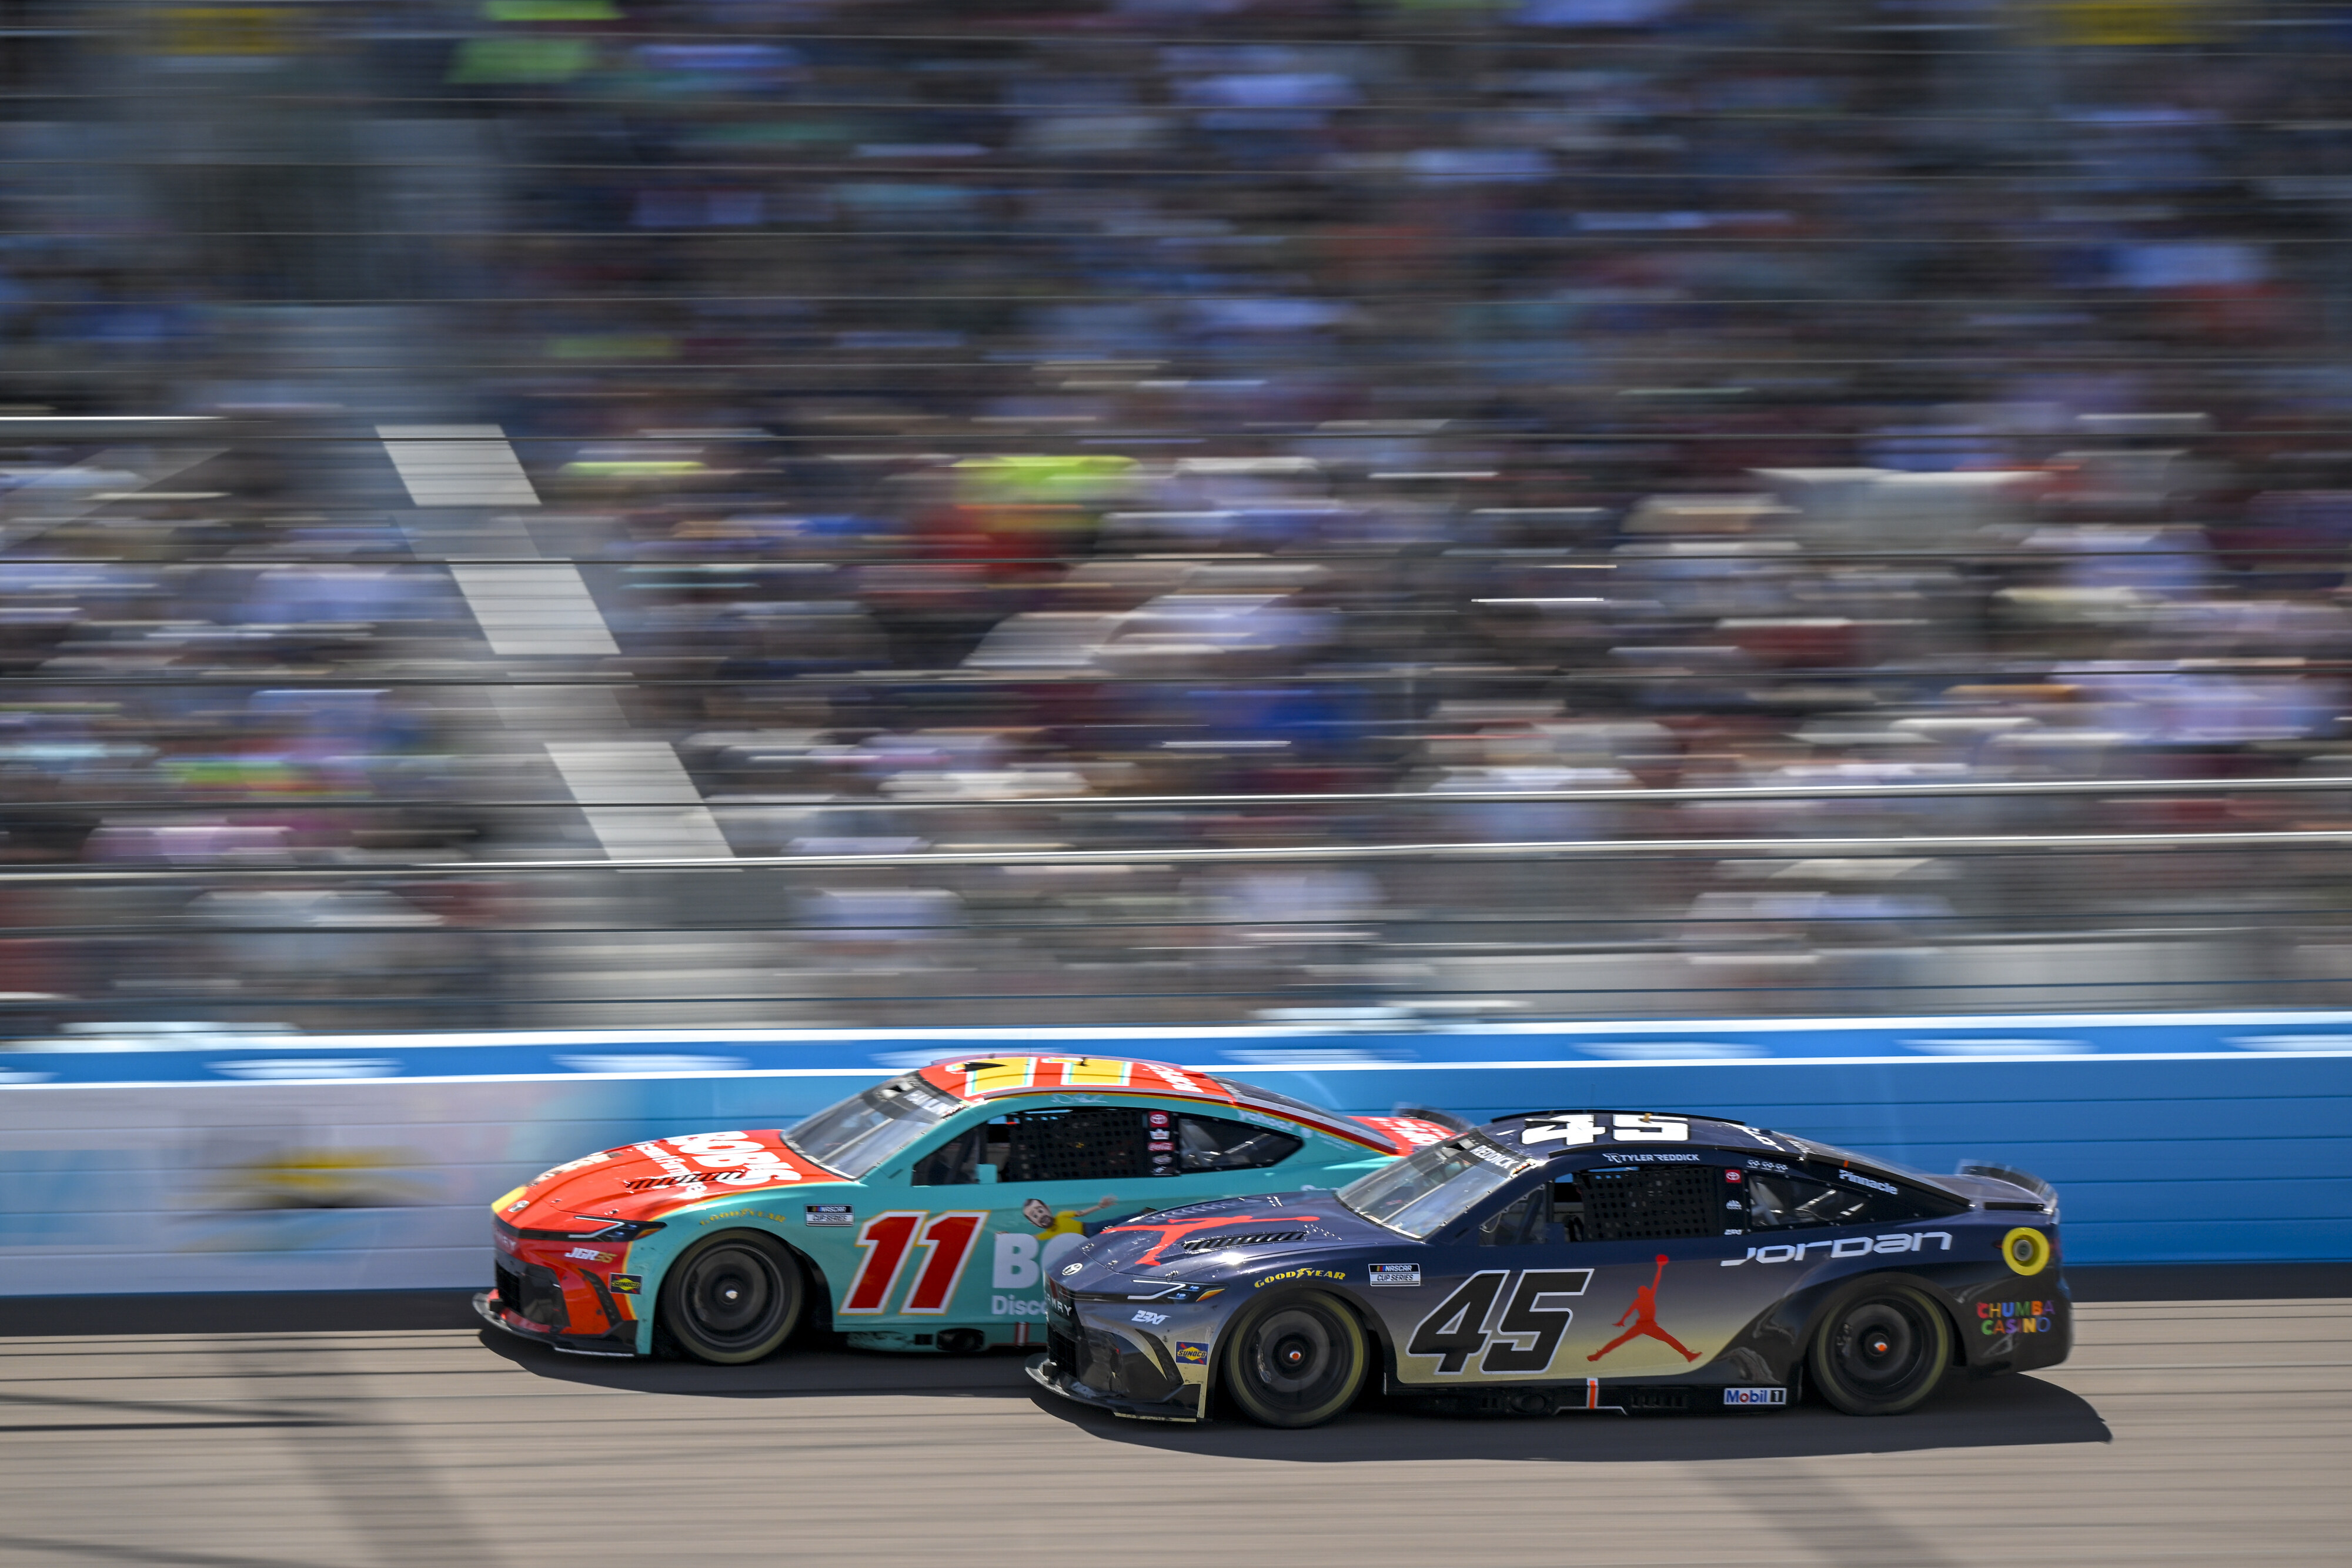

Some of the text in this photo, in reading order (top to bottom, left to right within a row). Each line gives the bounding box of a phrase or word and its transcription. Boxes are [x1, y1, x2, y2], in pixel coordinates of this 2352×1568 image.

[1522, 1114, 1688, 1146] 45
[1469, 1145, 1519, 1169] REDDICK
[1839, 1169, 1898, 1195] Pinnacle
[837, 1210, 991, 1316] 11
[612, 1278, 640, 1289] SUNOCO
[1254, 1268, 1346, 1288] GOODYEAR
[1976, 1300, 2056, 1319] CHUMBA
[1406, 1268, 1595, 1375] 45
[1981, 1317, 2052, 1336] CASINO
[1177, 1349, 1207, 1359] SUNOCO
[1726, 1389, 1767, 1403] Mobil
